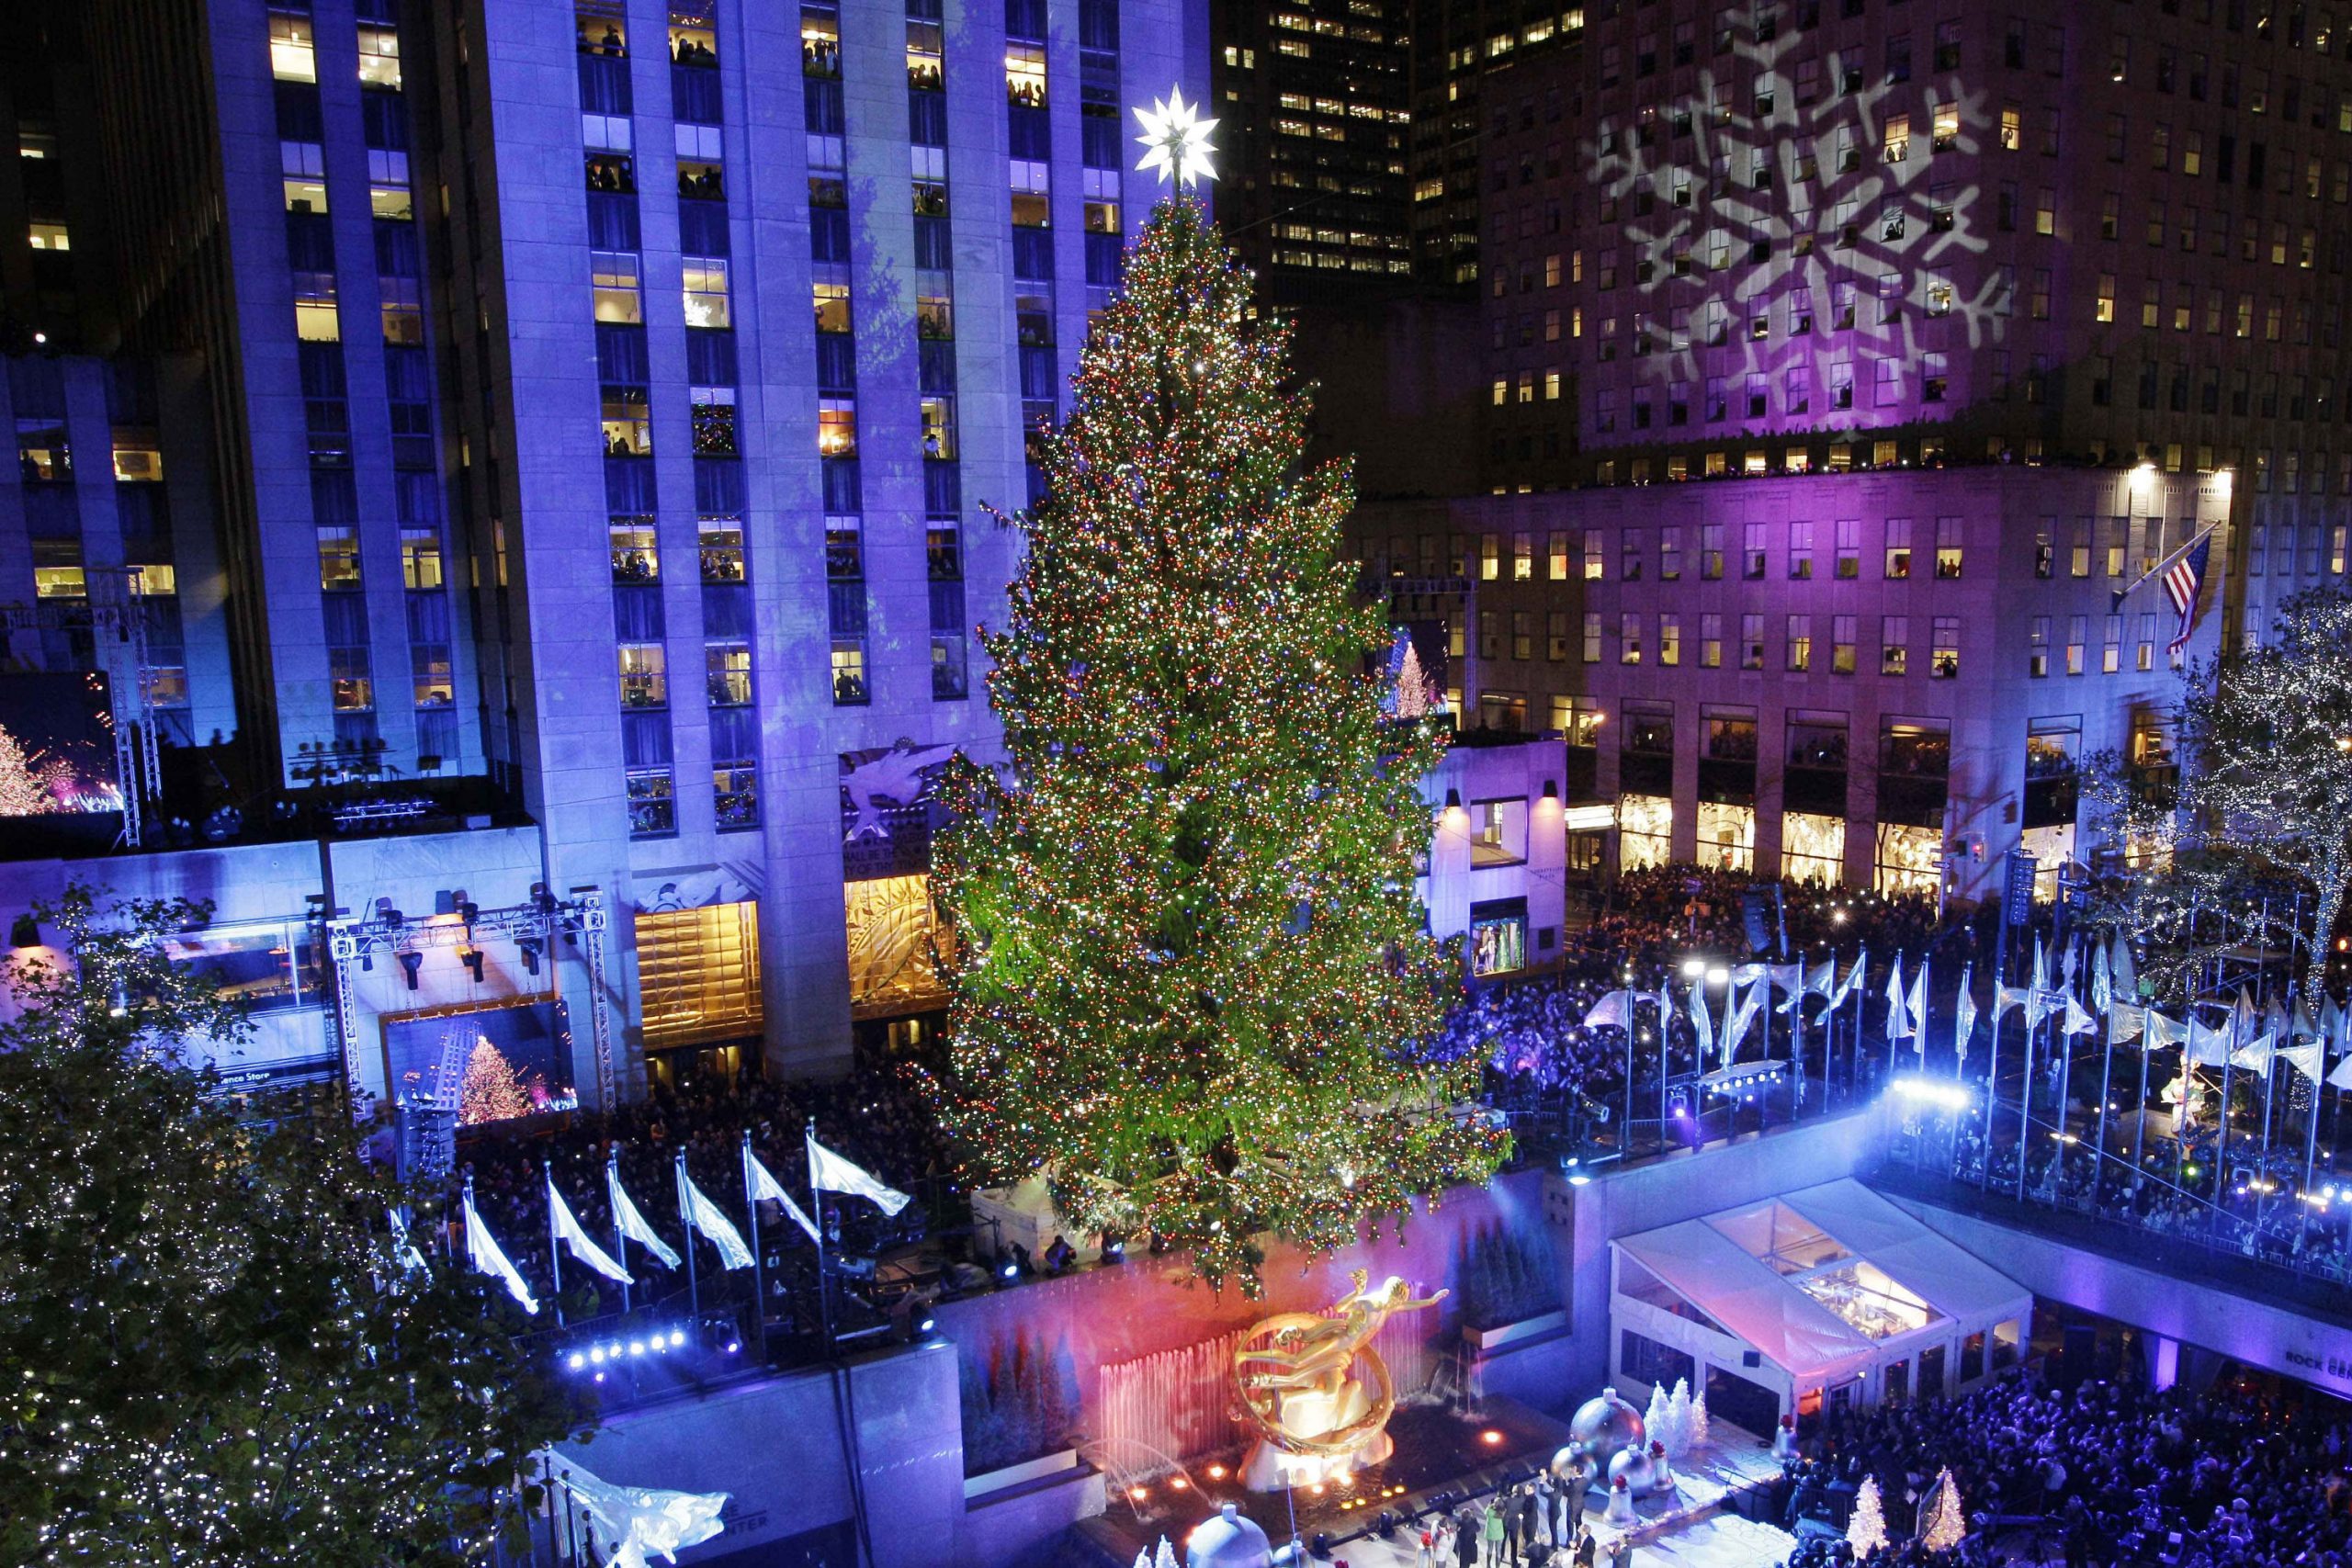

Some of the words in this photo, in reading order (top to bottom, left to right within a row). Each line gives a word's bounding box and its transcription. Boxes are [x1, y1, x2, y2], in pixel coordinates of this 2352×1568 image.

[220, 1076, 244, 1085] ience
[245, 1072, 270, 1081] Store
[2286, 1351, 2323, 1371] ROCK
[726, 1517, 767, 1536] NTER
